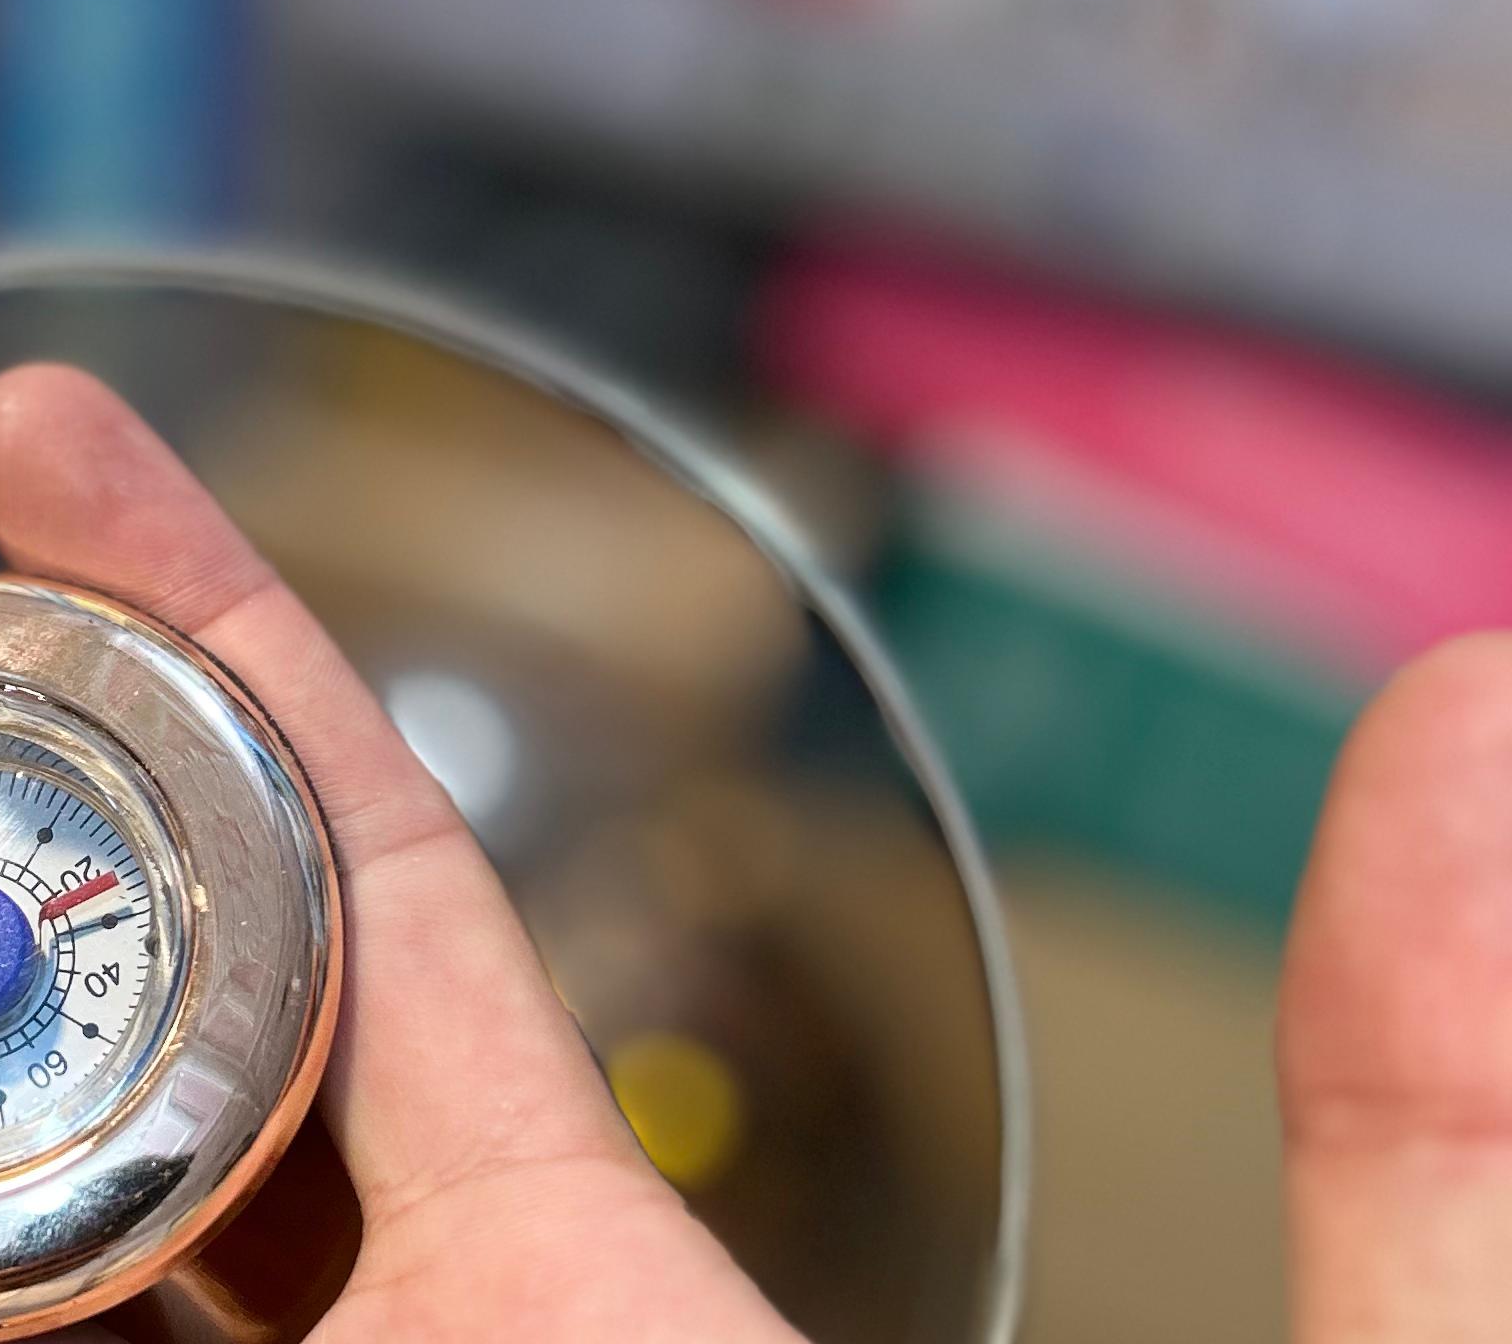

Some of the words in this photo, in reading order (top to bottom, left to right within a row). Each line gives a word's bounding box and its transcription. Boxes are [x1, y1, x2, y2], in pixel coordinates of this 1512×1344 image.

[61, 855, 101, 894] 20
[85, 962, 121, 998] 40
[28, 1050, 68, 1089] 60
